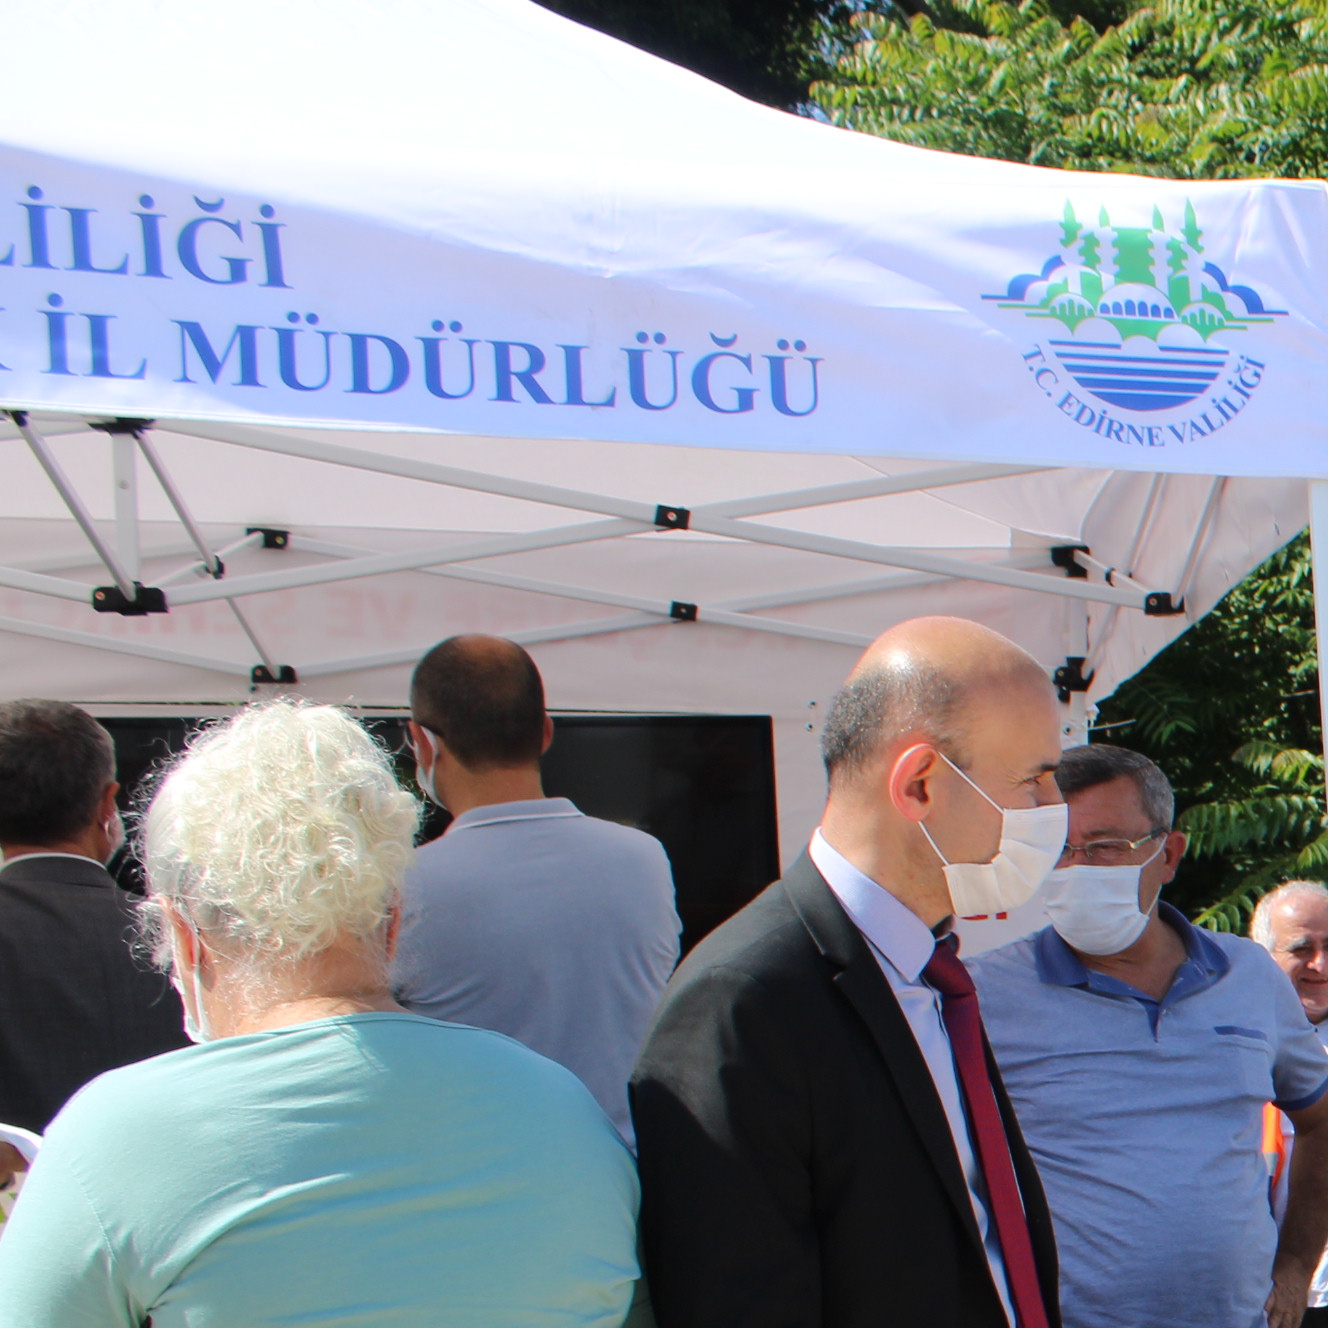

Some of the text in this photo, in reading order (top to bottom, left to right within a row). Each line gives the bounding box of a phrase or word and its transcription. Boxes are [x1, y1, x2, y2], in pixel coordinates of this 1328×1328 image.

[37, 292, 147, 382] İL
[171, 312, 824, 418] MÜDÜRLÜĞÜ
[1020, 342, 1266, 447] T.C. EDİRNE VALİLİĞİ
